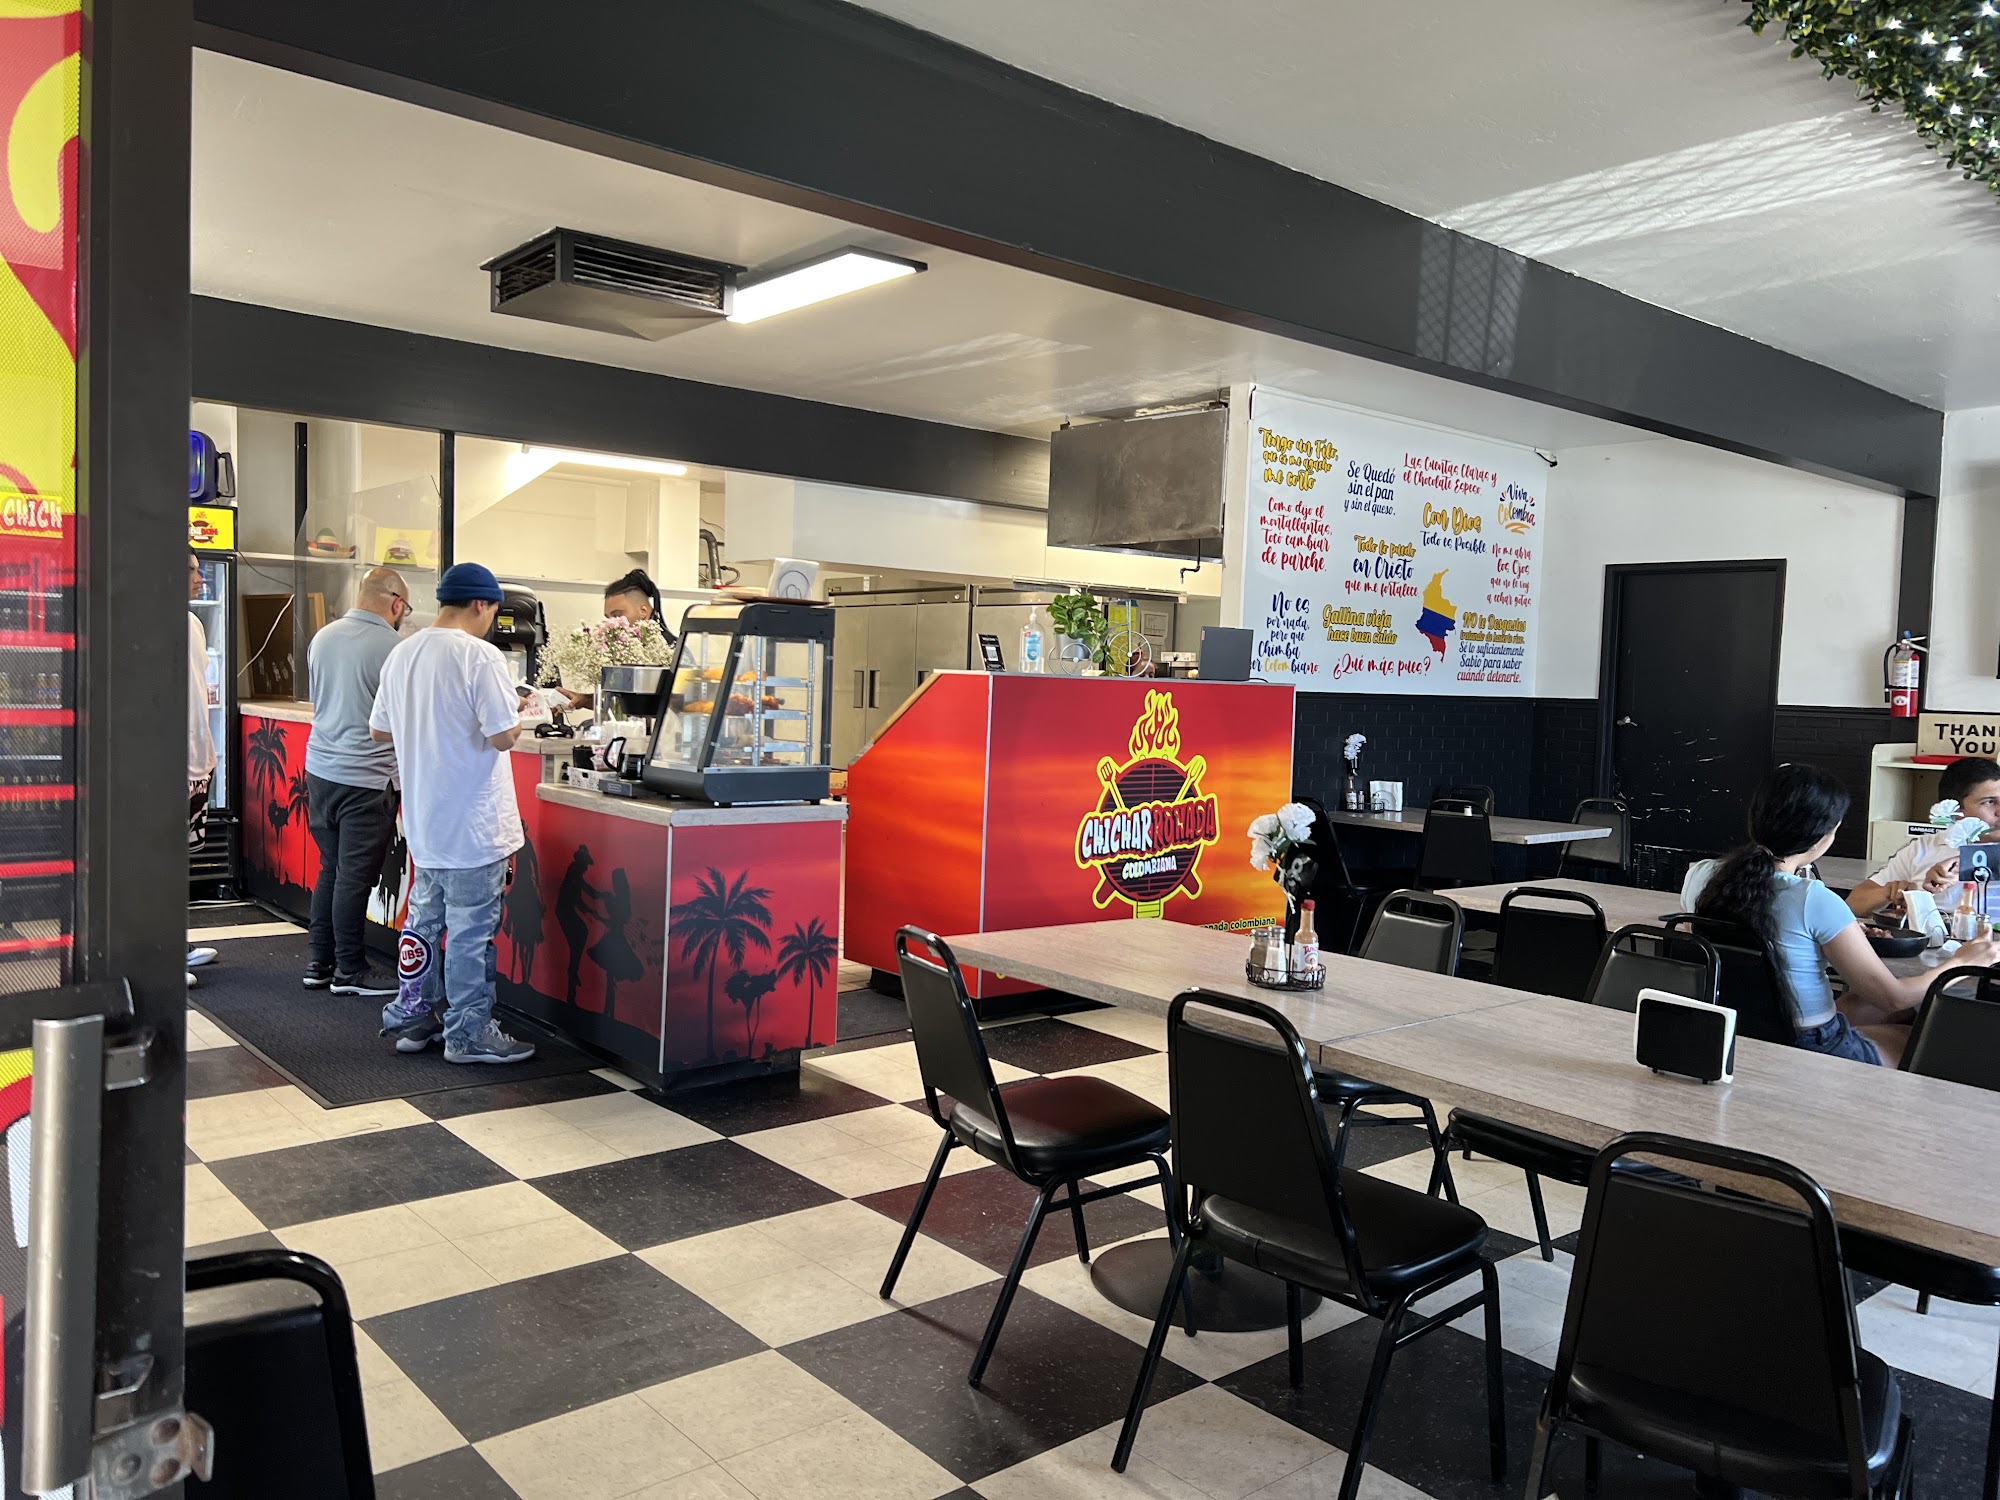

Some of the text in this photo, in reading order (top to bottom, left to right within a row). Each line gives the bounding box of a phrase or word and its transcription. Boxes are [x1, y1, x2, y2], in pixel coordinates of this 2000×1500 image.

[1258, 427, 1294, 453] Tengo
[1296, 439, 1313, 457] un
[1263, 451, 1277, 464] que
[1289, 455, 1302, 466] me
[1303, 458, 1332, 473] agacho
[1347, 460, 1395, 484] Se Quedó
[1404, 452, 1497, 488] Las Cuentas Claras y
[1264, 467, 1316, 491] me corto
[1403, 469, 1411, 483] el
[1414, 470, 1452, 491] Chocolate
[1348, 479, 1394, 503] sin el pan
[1507, 481, 1529, 502] Viva
[1268, 496, 1324, 520] Como dijo el
[1344, 498, 1396, 517] y sin el queso.
[1423, 502, 1481, 535] Con Dios
[1497, 501, 1536, 526] Colombia
[1261, 528, 1330, 552] Tocó cambiar
[1354, 535, 1416, 558] Todo lo puedo
[1420, 531, 1488, 554] Todo es Posible.
[1262, 546, 1327, 572] de parche.
[1492, 543, 1532, 560] No me abra
[1353, 556, 1414, 580] en Cristo
[1497, 558, 1530, 579] los Ojos
[1345, 580, 1361, 595] que
[1364, 582, 1378, 593] me
[1491, 578, 1530, 593] que no le voy
[1272, 591, 1310, 618] No es
[1487, 594, 1492, 604] a
[1494, 592, 1512, 606] echar
[1266, 616, 1309, 631] por nada,
[1323, 604, 1393, 632] Gallina vieja
[1271, 630, 1305, 644] pero que
[1327, 626, 1398, 645] hace buen caldo
[1258, 640, 1300, 659] Chimba
[1459, 641, 1525, 657] Sé lo suficientemente
[1250, 658, 1262, 672] er
[1333, 653, 1431, 679] ¿Qué más pues?
[1460, 654, 1522, 671] Sabio para saber
[1457, 668, 1521, 683] cuándo detenerte.
[1950, 738, 1996, 754] YOU
[1081, 798, 1216, 858] CHICHARRONADA
[1122, 855, 1177, 880] COLOMBIANA
[1230, 916, 1275, 930] colombiana
